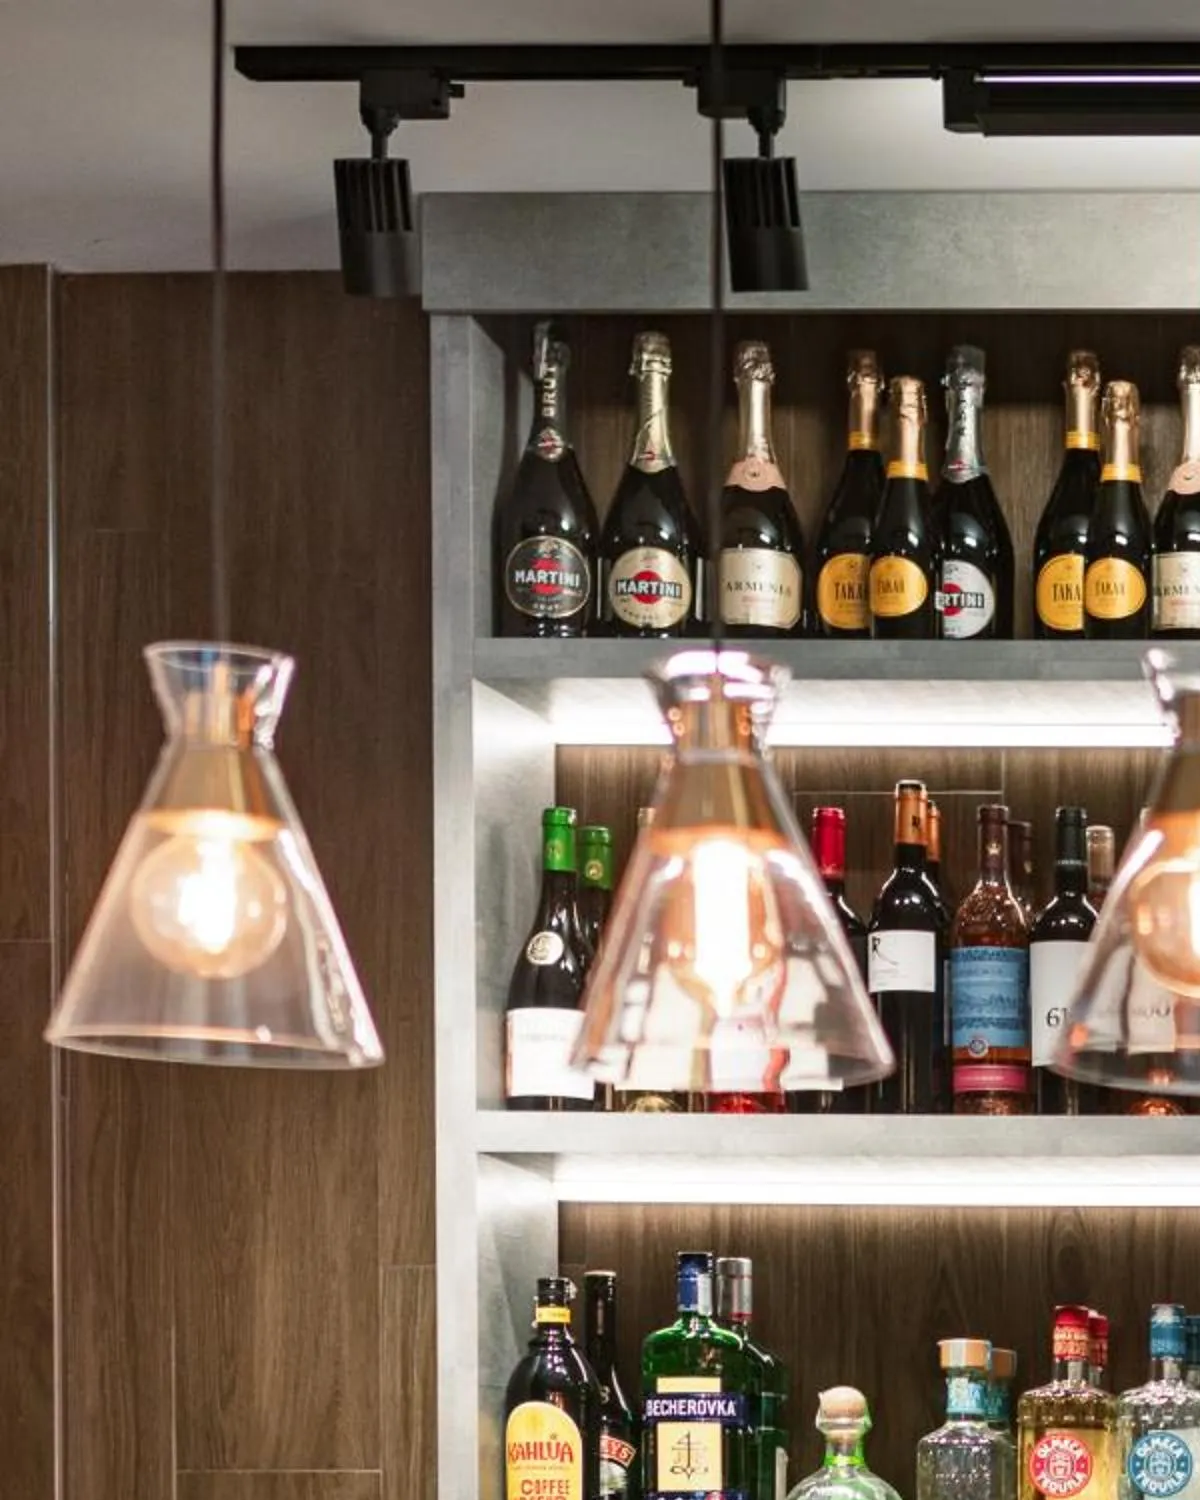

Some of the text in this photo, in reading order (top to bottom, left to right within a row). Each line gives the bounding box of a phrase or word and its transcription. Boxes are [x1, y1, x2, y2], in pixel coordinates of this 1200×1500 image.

[514, 569, 581, 588] MARTINI
[616, 581, 683, 600] MARTINI
[834, 582, 867, 602] TAKA
[1051, 583, 1082, 602] TAKA
[645, 1399, 738, 1417] BECHEROVKA
[520, 1479, 570, 1496] COFFEE
